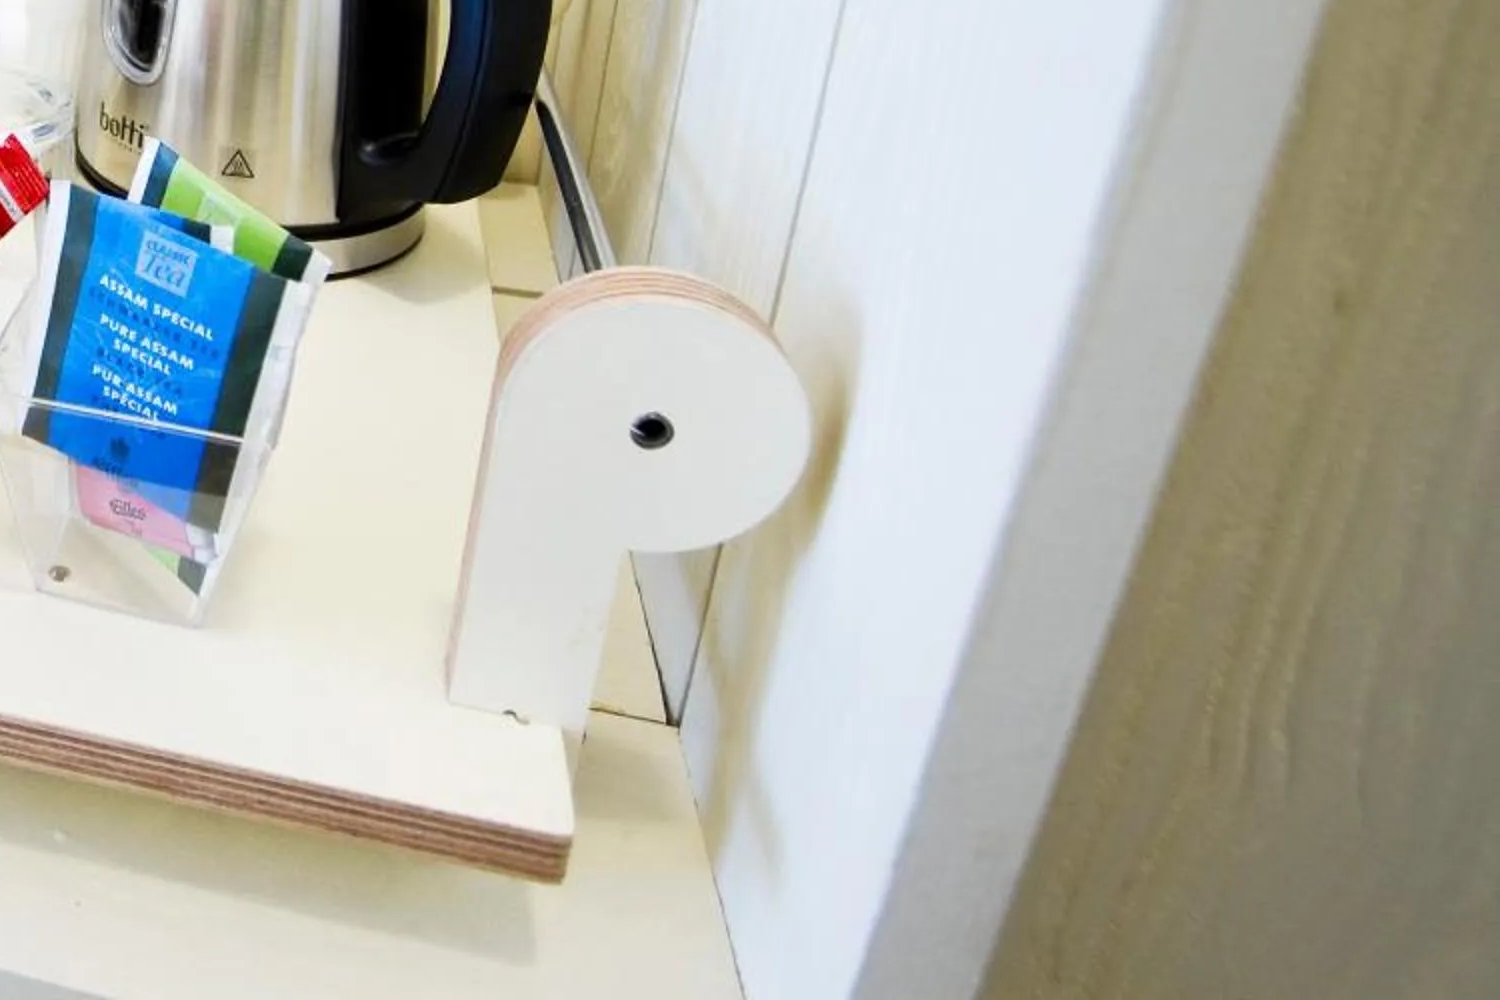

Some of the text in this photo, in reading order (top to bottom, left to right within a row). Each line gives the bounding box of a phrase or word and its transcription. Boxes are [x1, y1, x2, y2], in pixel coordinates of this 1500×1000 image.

[99, 274, 148, 311] ASSAM
[152, 303, 214, 341] SPECIAL
[99, 313, 137, 343] PURE
[141, 336, 194, 371] ASSAM
[113, 337, 171, 375] SPECIAL
[124, 382, 178, 417] ASSAM
